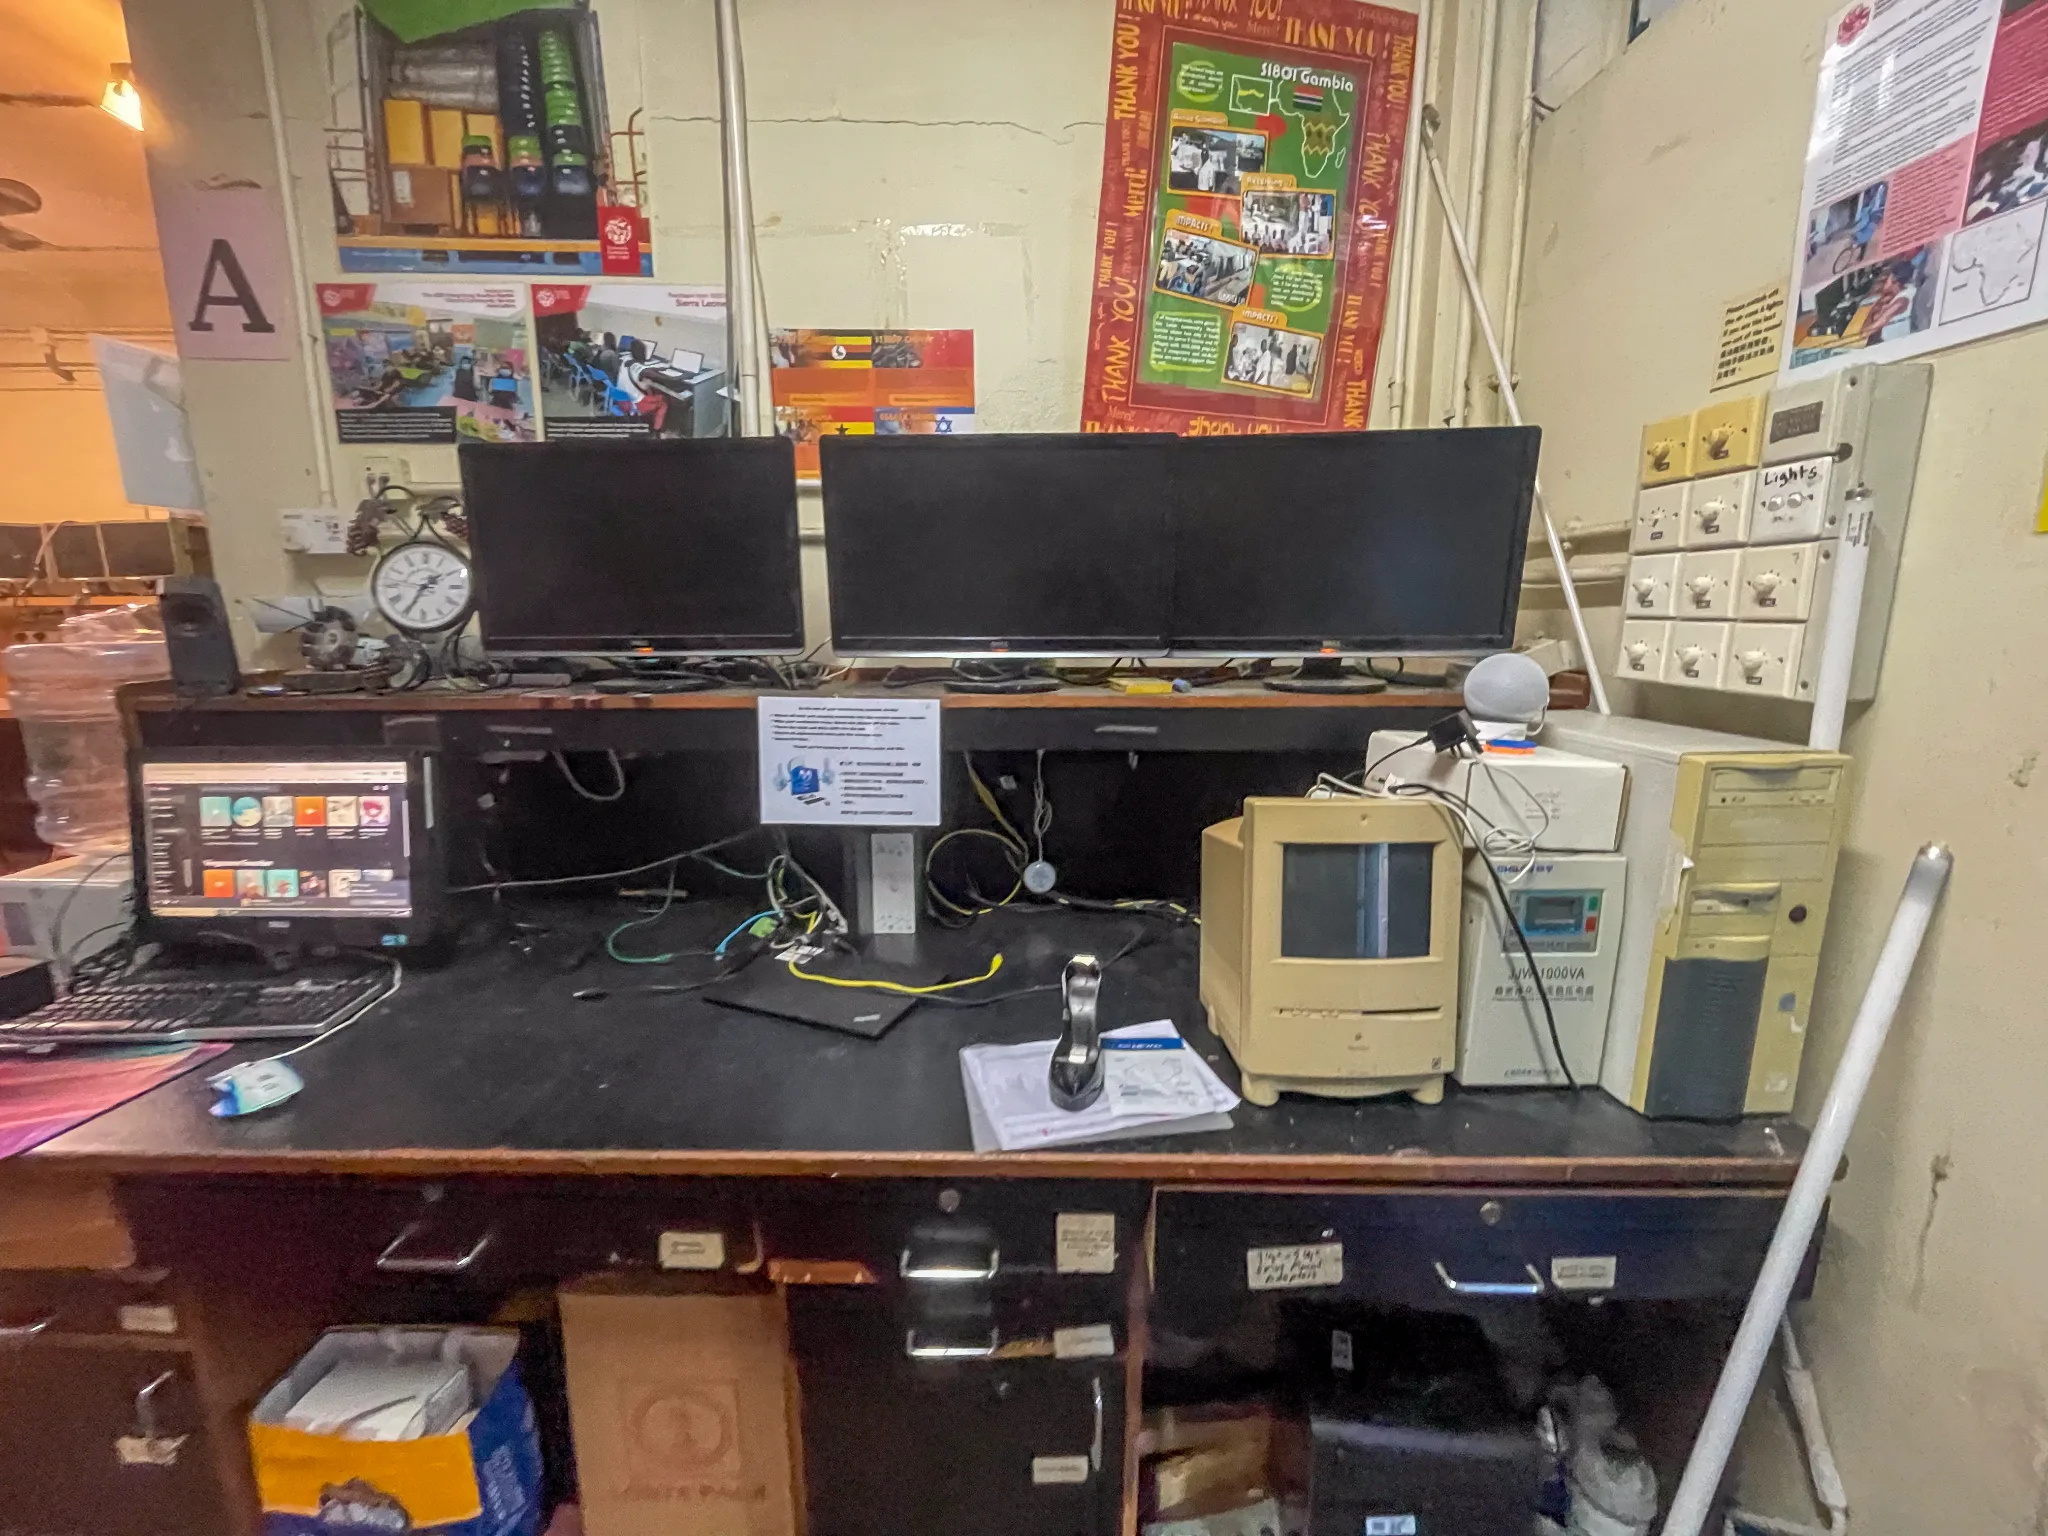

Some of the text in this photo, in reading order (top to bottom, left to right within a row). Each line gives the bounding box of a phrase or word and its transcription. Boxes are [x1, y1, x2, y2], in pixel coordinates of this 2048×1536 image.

[1113, 63, 1138, 120] THANK
[1301, 70, 1354, 93] Gambia
[1361, 132, 1391, 190] THANK
[1121, 167, 1148, 218] Merci!
[188, 238, 275, 333] A
[1098, 255, 1114, 288] THANK
[1101, 276, 1137, 403] THANK YOU!
[1343, 379, 1368, 428] THANK
[1764, 465, 1818, 488] Lights
